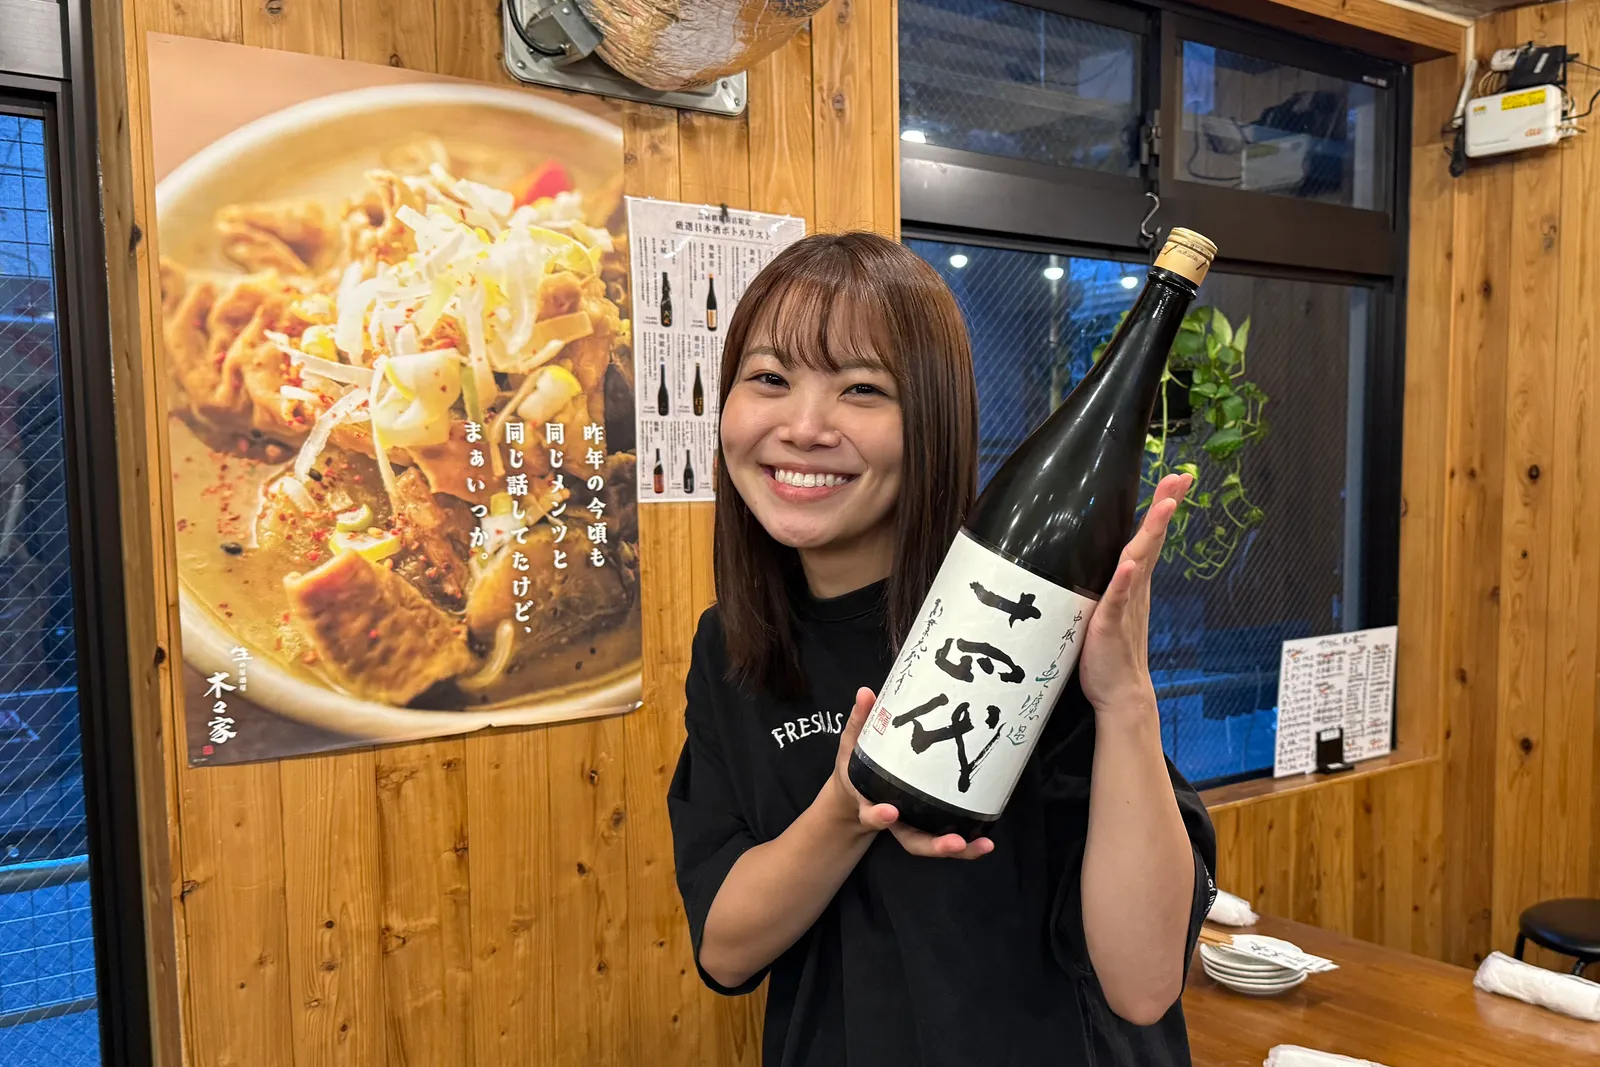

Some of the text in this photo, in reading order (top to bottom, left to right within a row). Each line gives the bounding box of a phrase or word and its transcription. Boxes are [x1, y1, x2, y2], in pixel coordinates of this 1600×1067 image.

[505, 422, 534, 633] 同じ話してたけど、
[545, 422, 568, 569] 同じメンツと
[583, 422, 608, 568] 昨年の今頃も
[203, 672, 238, 744] 木々家
[892, 581, 1042, 793] 十四代
